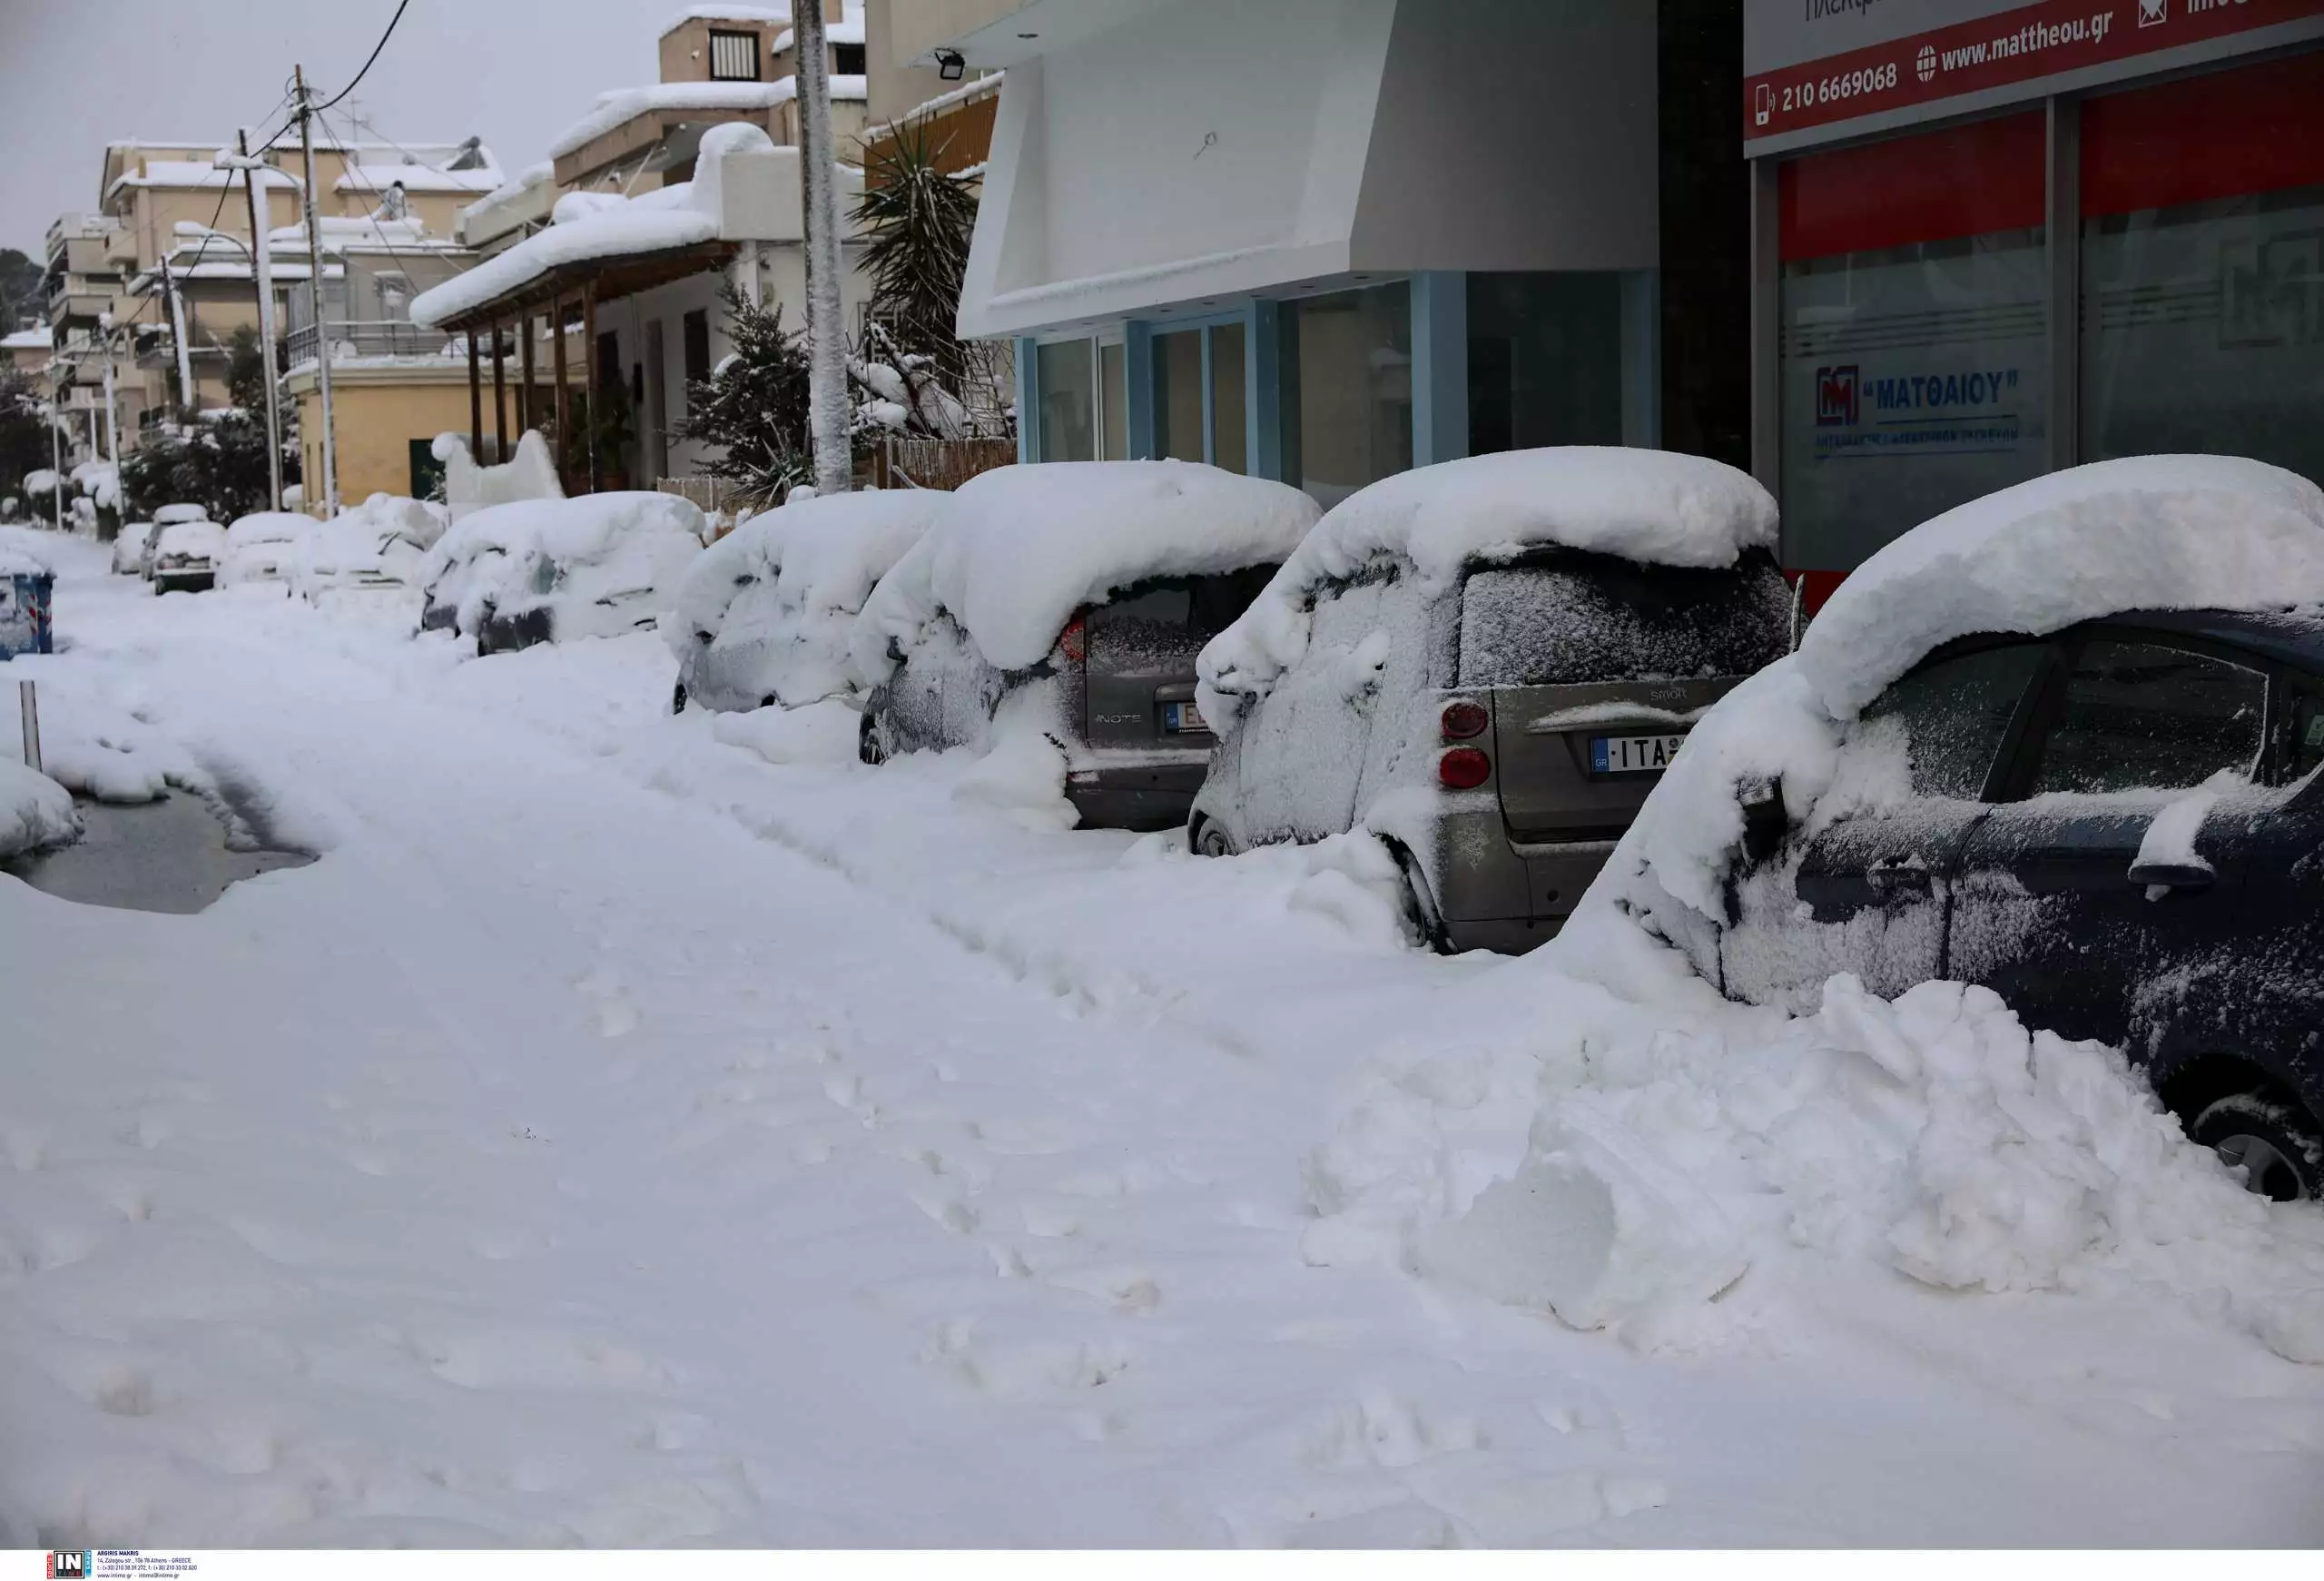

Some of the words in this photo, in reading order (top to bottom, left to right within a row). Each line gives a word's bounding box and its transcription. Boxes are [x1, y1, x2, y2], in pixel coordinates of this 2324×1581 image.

[1941, 11, 2113, 72] www.mattheou.gr
[1782, 82, 1814, 112] 210
[1818, 62, 1897, 103] 6669068
[1595, 758, 1608, 768] GR
